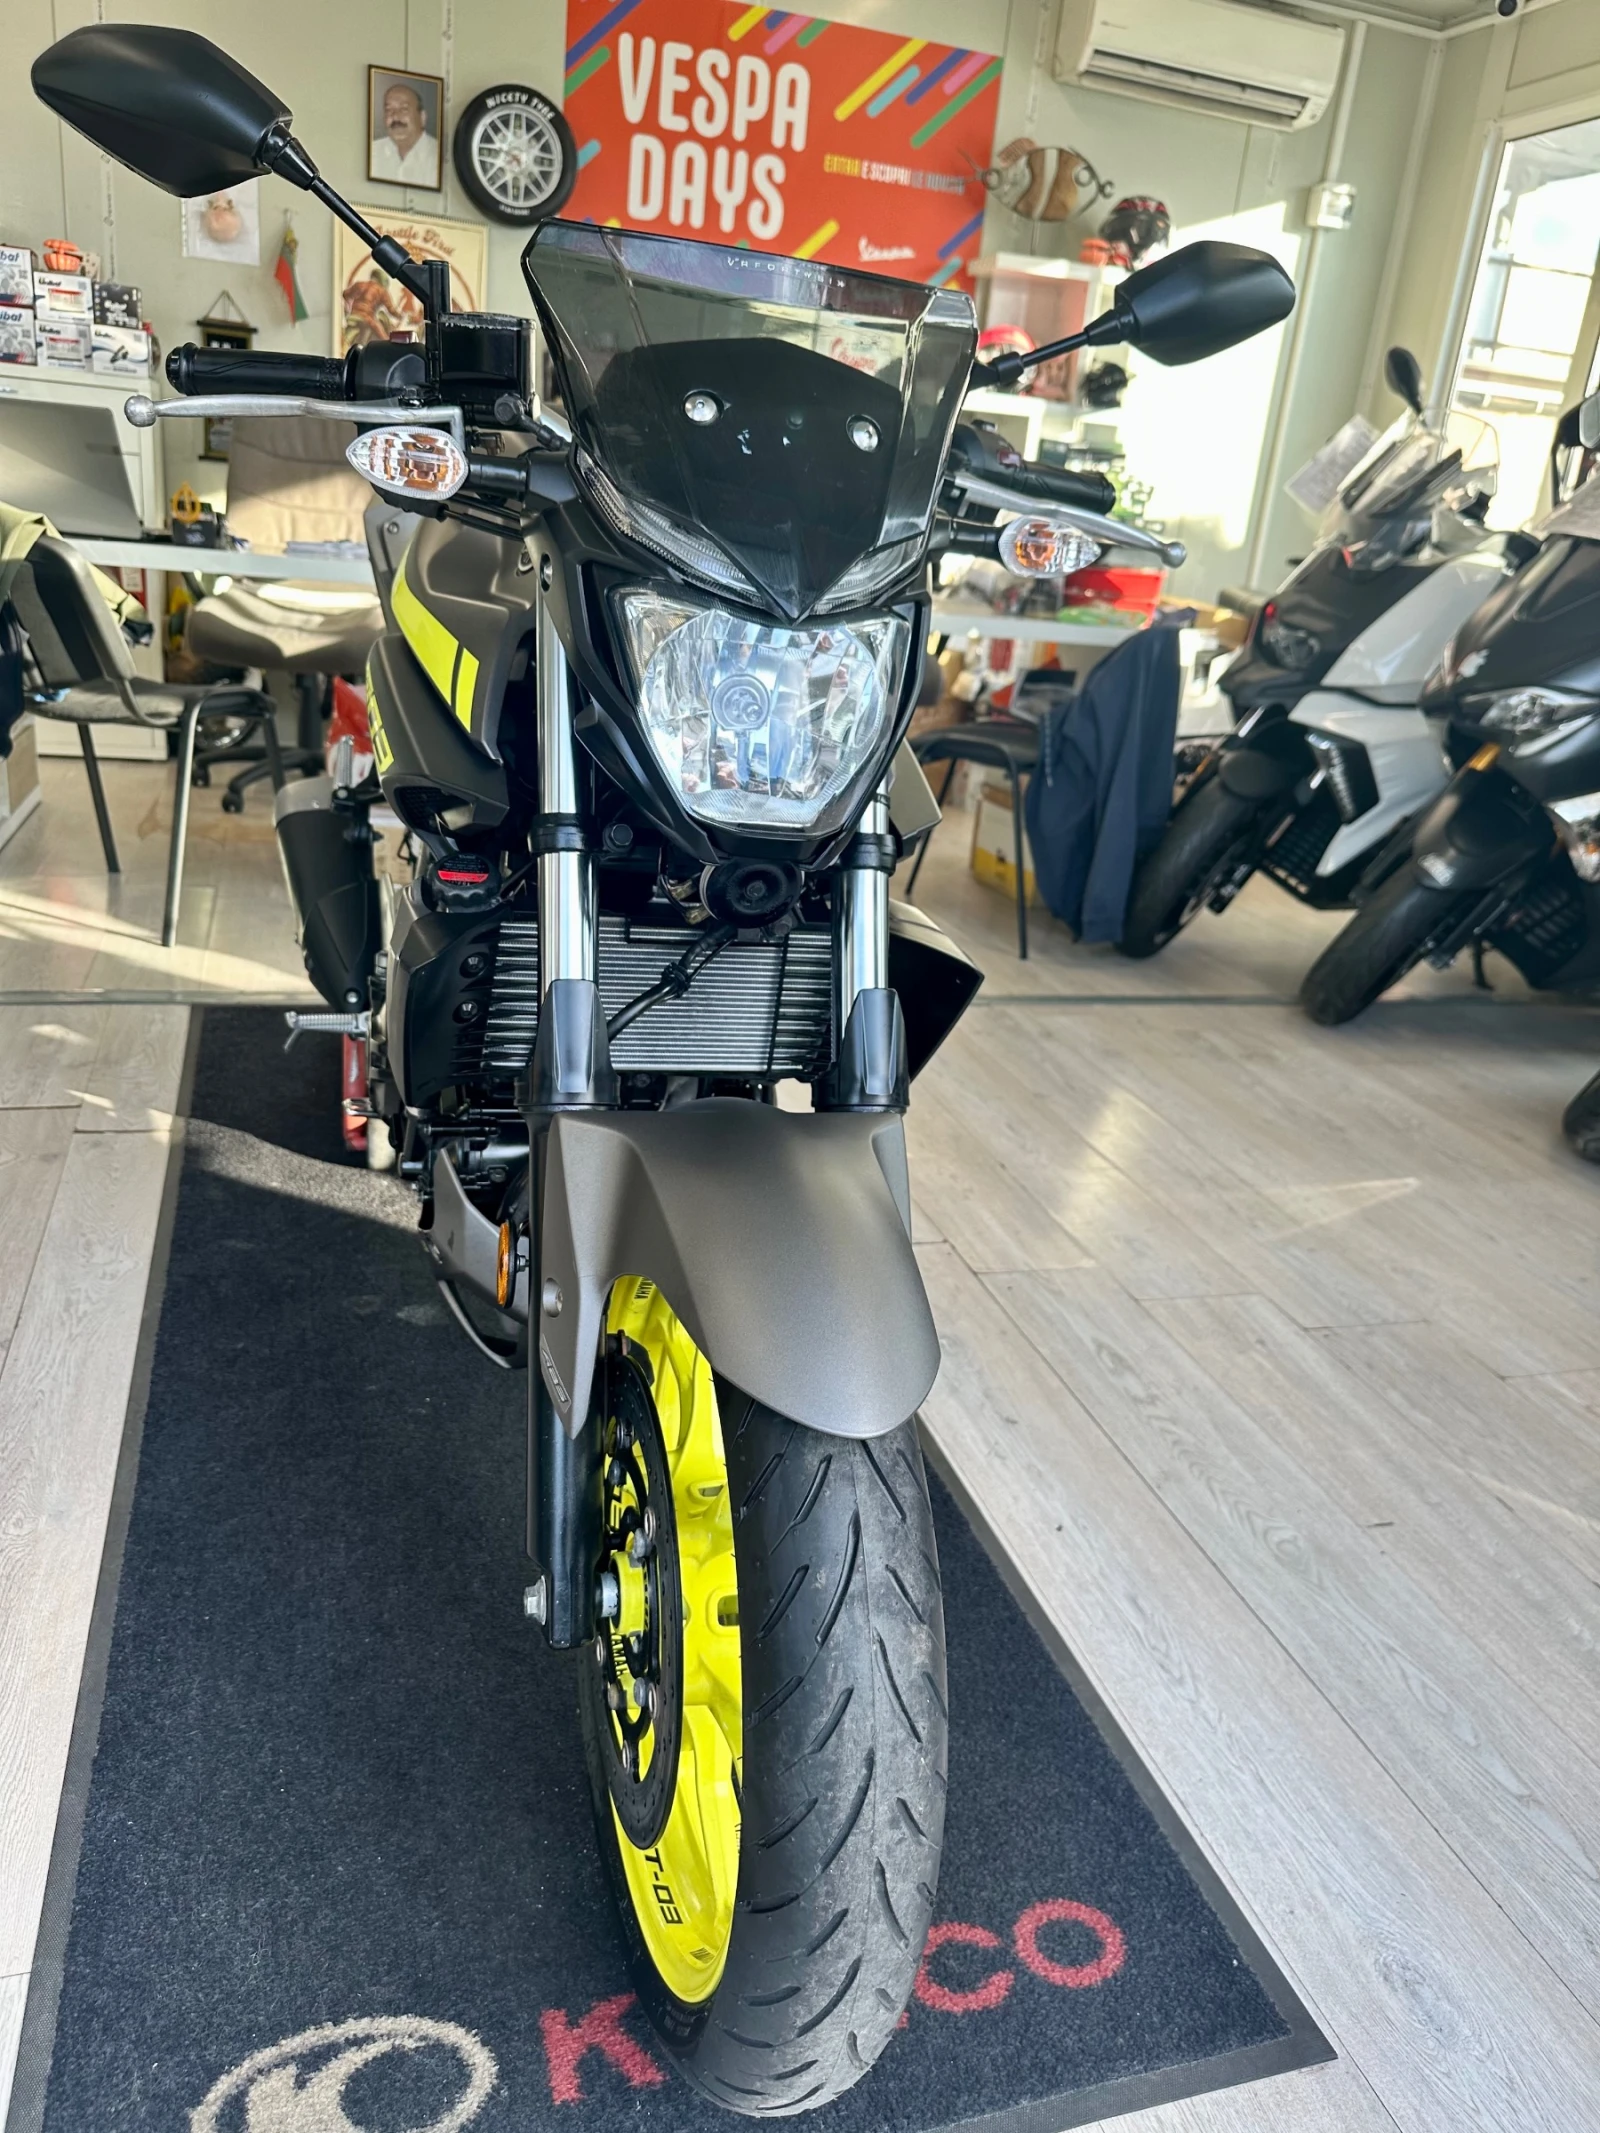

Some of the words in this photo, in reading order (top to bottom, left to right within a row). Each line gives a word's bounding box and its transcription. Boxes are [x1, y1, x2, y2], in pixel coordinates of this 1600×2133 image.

[617, 31, 812, 153] VESPA
[626, 132, 787, 241] DAYS
[644, 1847, 684, 1925] T-03
